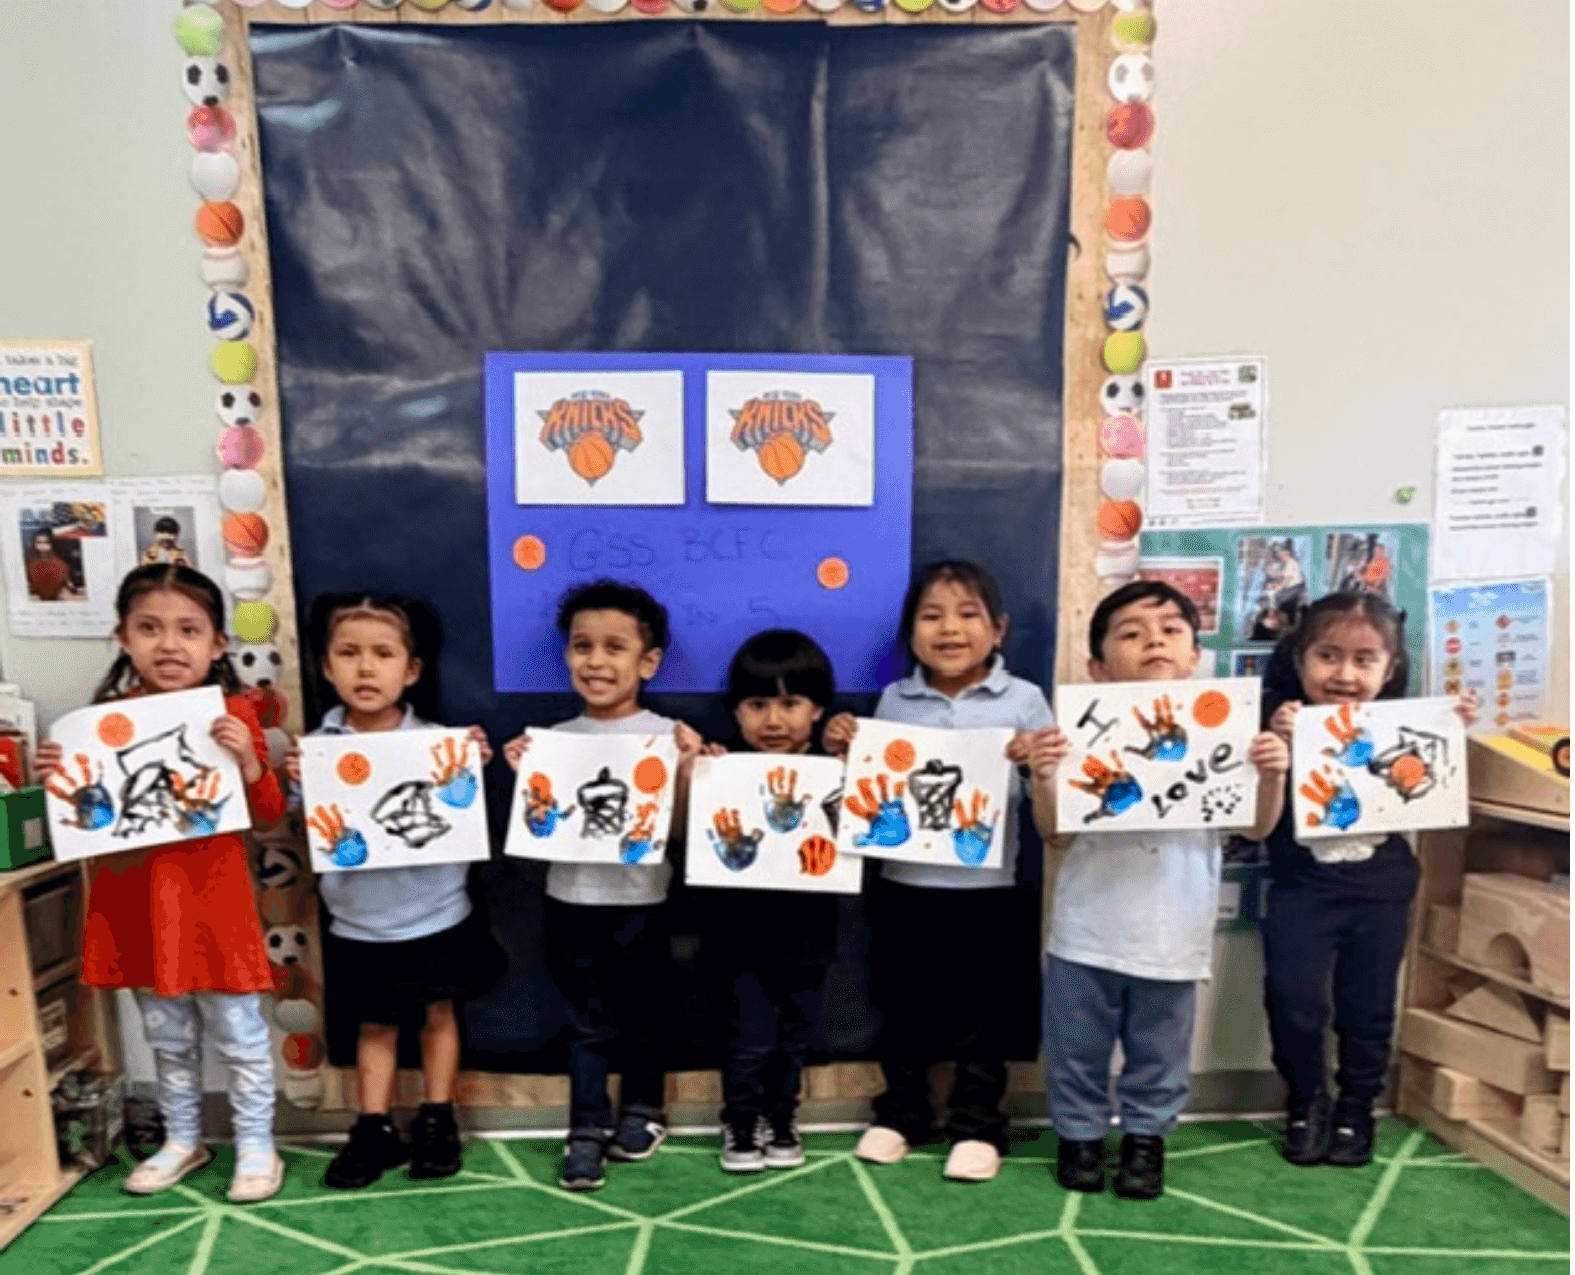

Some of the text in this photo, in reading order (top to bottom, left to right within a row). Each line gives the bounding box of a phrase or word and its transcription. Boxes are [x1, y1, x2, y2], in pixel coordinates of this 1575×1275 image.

[539, 398, 644, 452] KNICKS
[730, 398, 834, 453] KNICKS
[2, 441, 89, 464] minds.
